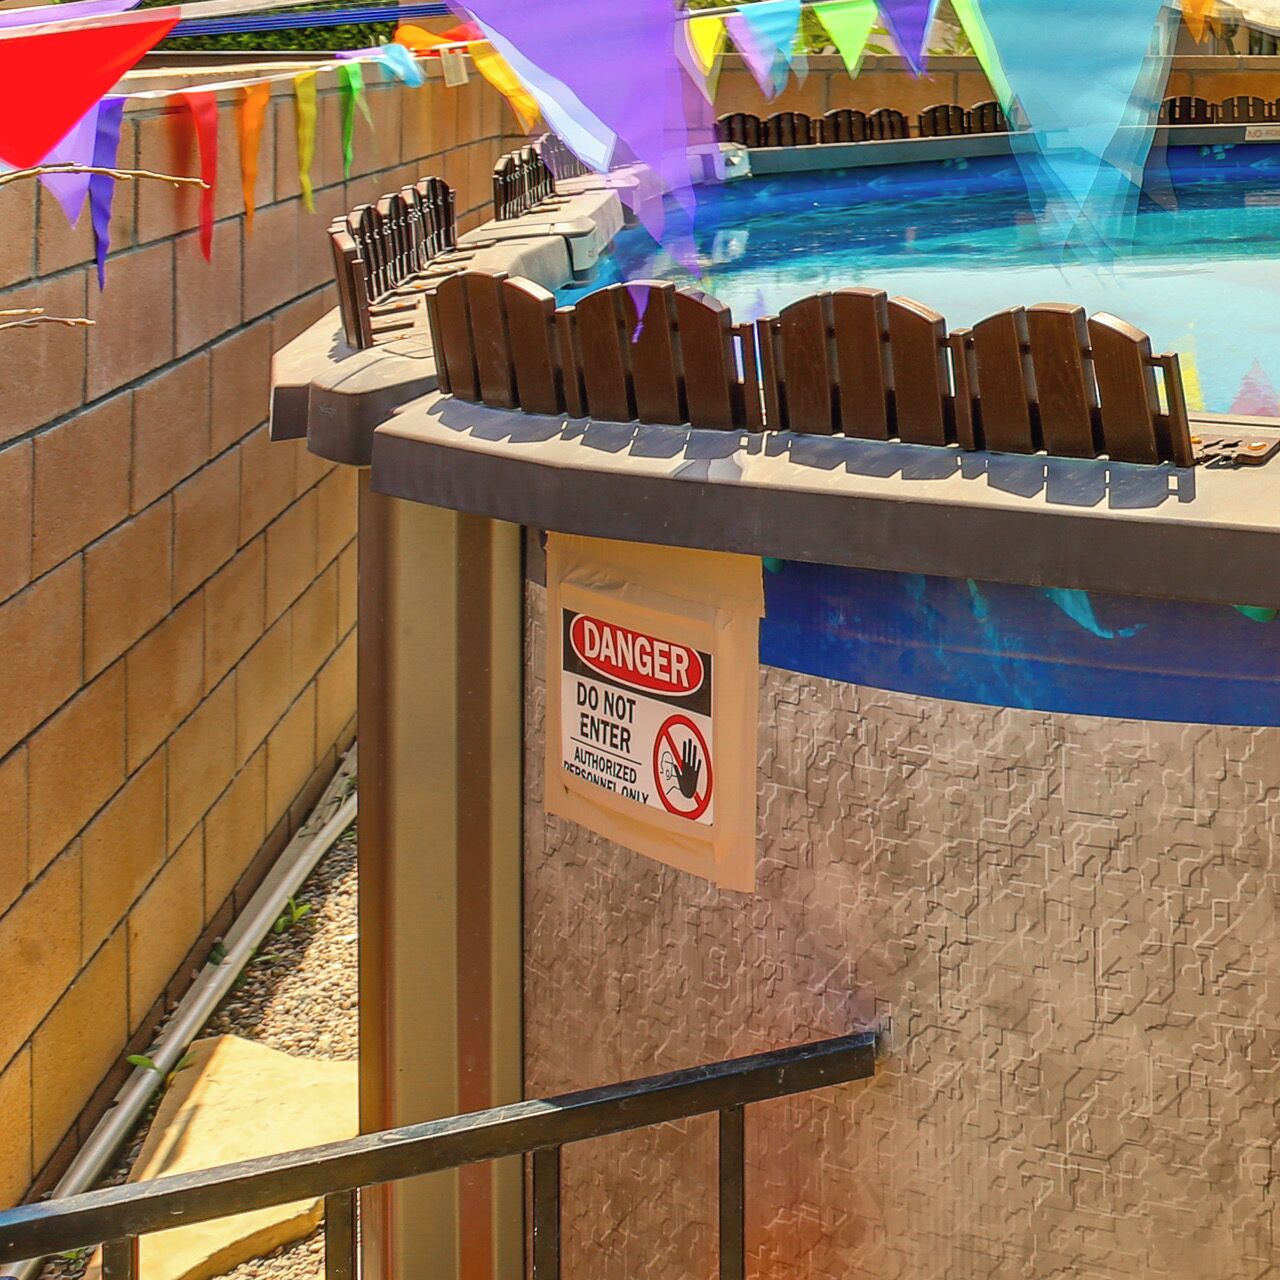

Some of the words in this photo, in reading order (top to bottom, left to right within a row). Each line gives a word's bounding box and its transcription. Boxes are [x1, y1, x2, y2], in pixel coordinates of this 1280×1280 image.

[1247, 129, 1262, 138] NO
[583, 619, 690, 688] DANGER
[577, 681, 598, 710] DO
[604, 690, 636, 724] NOT
[580, 713, 631, 753] ENTER
[574, 746, 637, 784] AUTHORIZED
